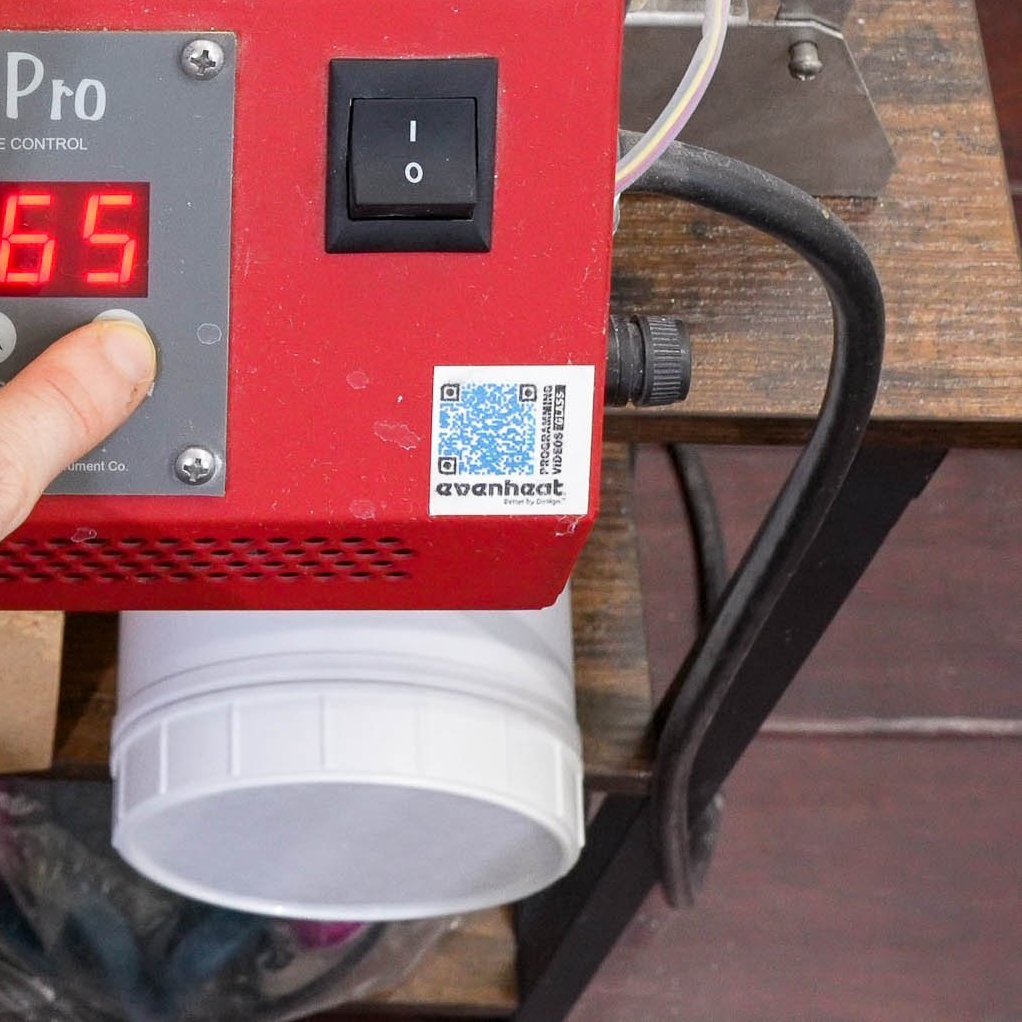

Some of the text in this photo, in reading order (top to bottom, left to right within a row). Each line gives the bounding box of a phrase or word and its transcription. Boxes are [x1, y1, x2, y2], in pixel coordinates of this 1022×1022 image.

[10, 137, 88, 150] CONTROL
[540, 385, 554, 476] PROGRAMMING
[551, 432, 564, 476] VIDEOS
[107, 460, 129, 472] Co.
[435, 478, 564, 497] evenheat
